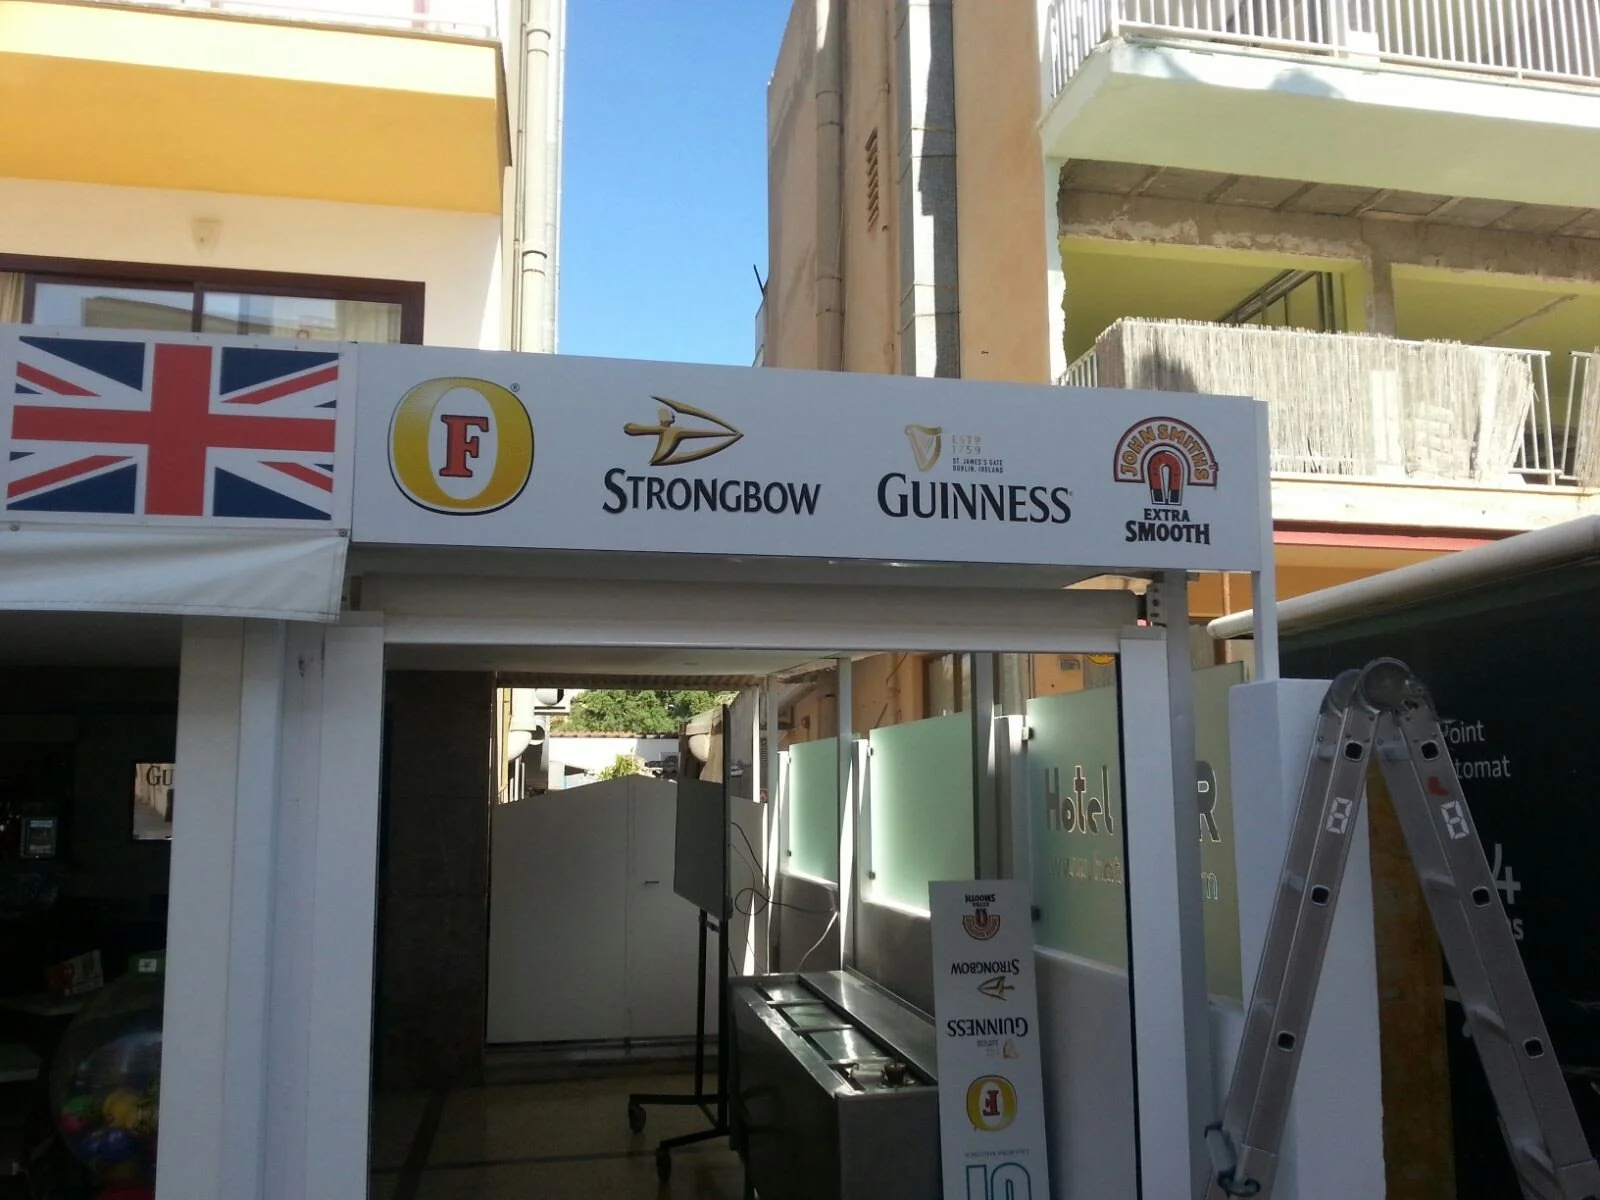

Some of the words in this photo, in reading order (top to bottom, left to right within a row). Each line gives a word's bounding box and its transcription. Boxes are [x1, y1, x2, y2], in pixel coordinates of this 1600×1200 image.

[952, 445, 982, 455] 1759
[1120, 425, 1157, 477] JOHN
[978, 466, 1004, 474] IRELAND
[602, 467, 822, 516] STRONGBOW
[877, 472, 1073, 524] GUINNESS
[1143, 508, 1191, 522] EXTRA
[1125, 520, 1211, 545] SMOOTH
[1045, 764, 1115, 836] Hotel
[1325, 796, 1353, 835] 8
[1440, 799, 1470, 840] 8
[951, 959, 1020, 976] STRONGBOW
[947, 1017, 1028, 1038] GUINNESS
